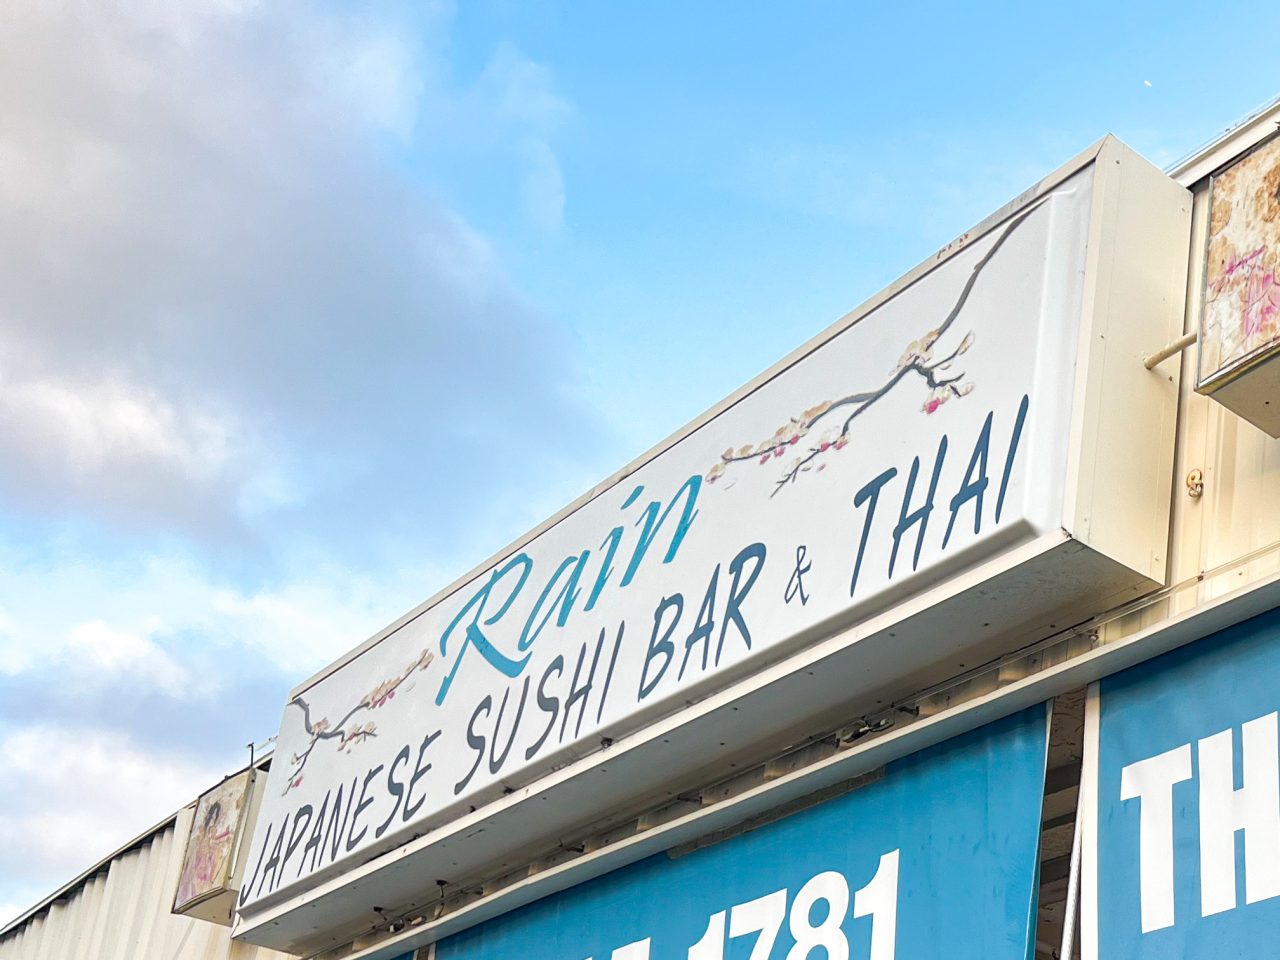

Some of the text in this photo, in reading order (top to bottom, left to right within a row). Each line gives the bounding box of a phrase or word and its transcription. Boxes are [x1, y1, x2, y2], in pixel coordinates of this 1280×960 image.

[240, 394, 1029, 907] JAPANESE SUSHI BAR & THAI
[435, 474, 703, 706] Rain
